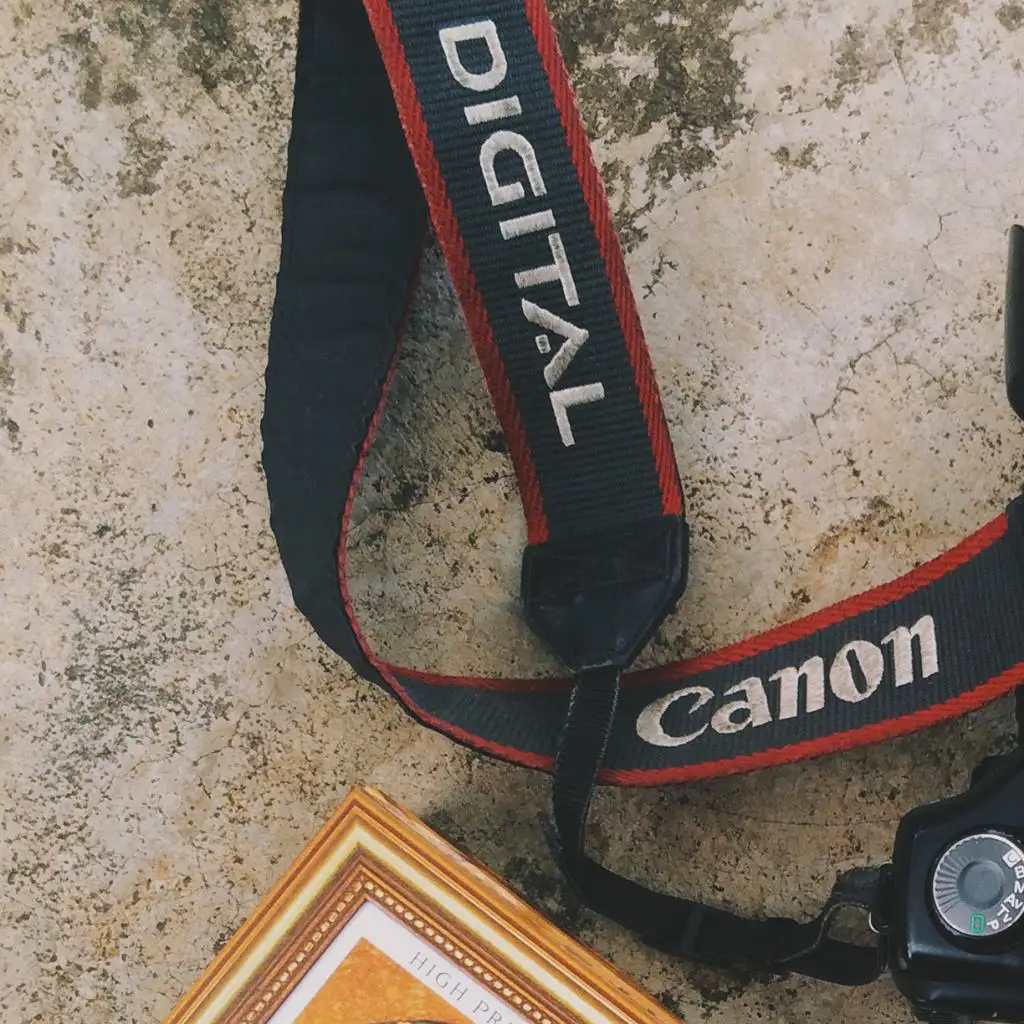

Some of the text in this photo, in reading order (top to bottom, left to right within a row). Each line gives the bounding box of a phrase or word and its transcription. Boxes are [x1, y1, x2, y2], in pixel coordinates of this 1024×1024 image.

[439, 20, 604, 447] DIGITAL
[636, 614, 939, 747] Canon
[997, 903, 1013, 924] Tv
[1003, 892, 1024, 910] Av
[408, 951, 469, 1001] HIGH
